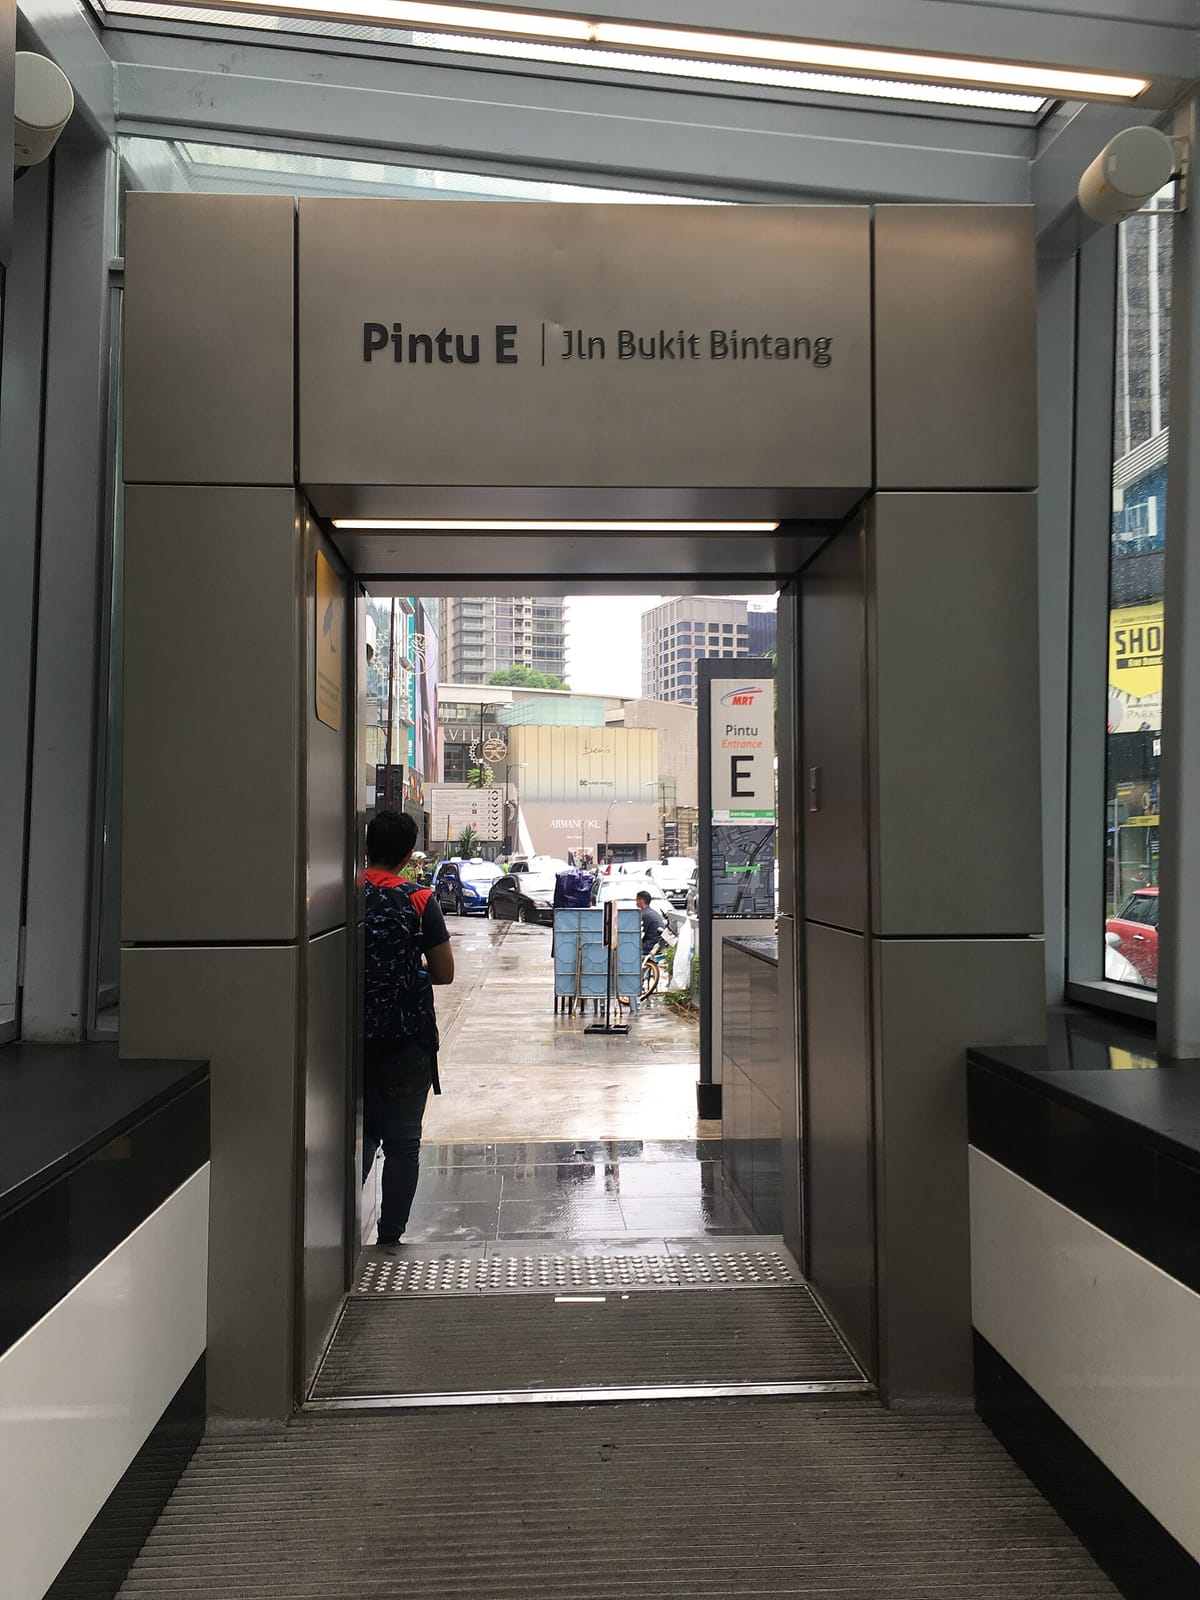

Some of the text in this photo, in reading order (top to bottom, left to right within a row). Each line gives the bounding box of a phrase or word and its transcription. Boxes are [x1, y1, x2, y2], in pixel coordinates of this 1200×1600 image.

[363, 322, 834, 369] Pintu E Jln Bukit Bintang
[732, 696, 754, 706] MRT
[725, 724, 759, 737] Pintu
[721, 739, 763, 749] Entrance
[731, 755, 755, 798] E
[550, 819, 581, 829] ARMANI
